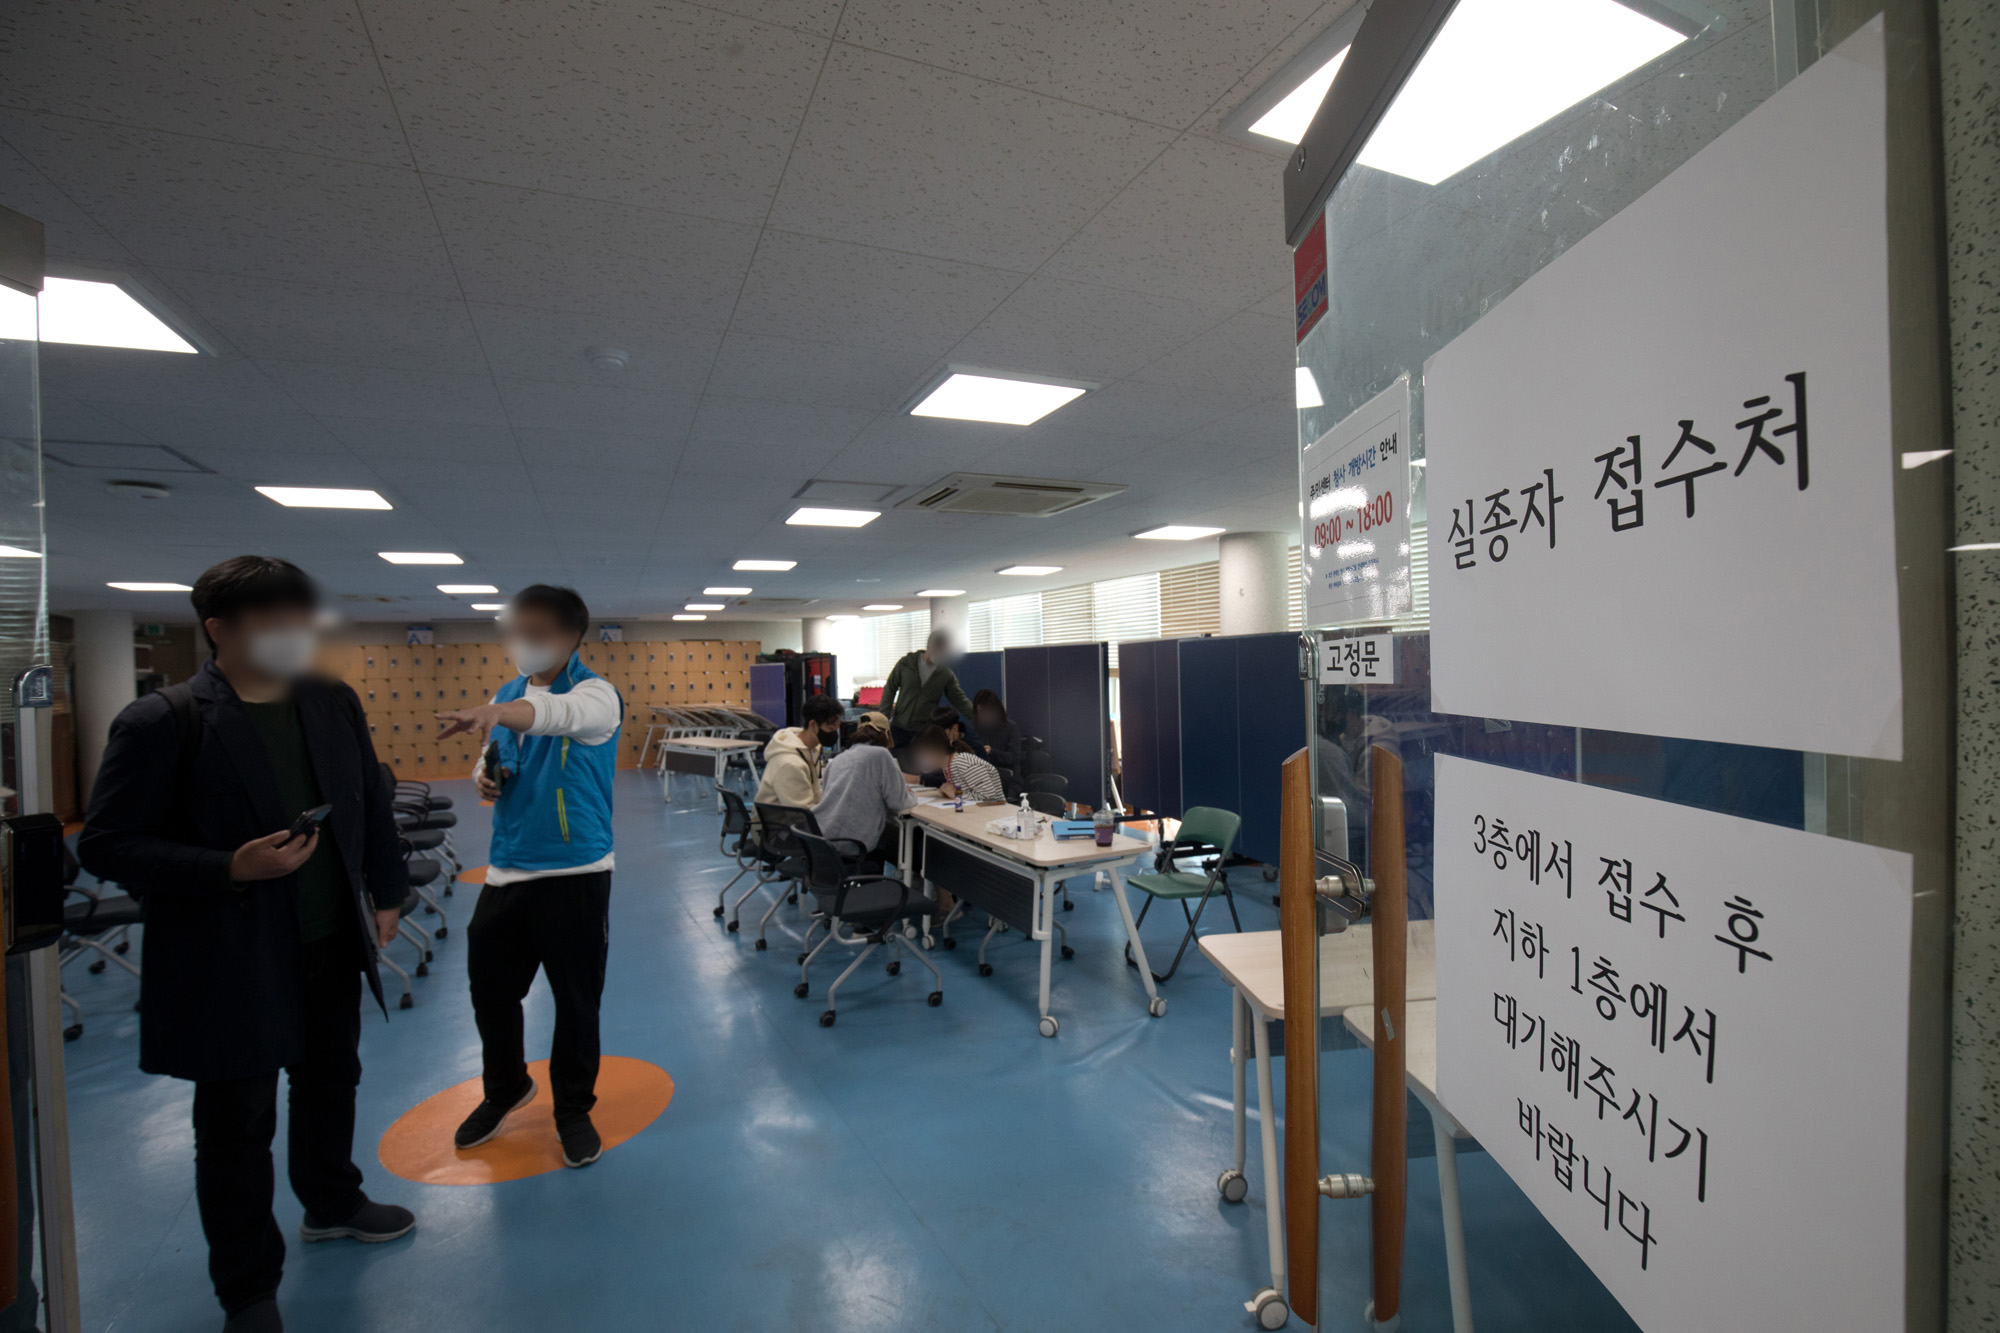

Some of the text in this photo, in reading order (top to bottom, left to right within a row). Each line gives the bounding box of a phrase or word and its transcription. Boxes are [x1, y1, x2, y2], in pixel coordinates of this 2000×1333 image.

[1298, 273, 1326, 328] SECOM
[1314, 514, 1342, 549] 09:00
[1357, 491, 1393, 534] 18:00
[1333, 464, 1346, 488] 청사
[1348, 445, 1377, 478] 개방시간
[1379, 432, 1397, 462] 안내
[1447, 371, 1810, 570] 실종자 접수처
[1326, 640, 1380, 678] 고정문
[1473, 814, 1774, 974] 3층에서 접수 후
[1492, 908, 1717, 1085] 지하 1층에서
[1493, 992, 1708, 1204] 대기해주시기
[1516, 1097, 1658, 1271] 바랍니다
